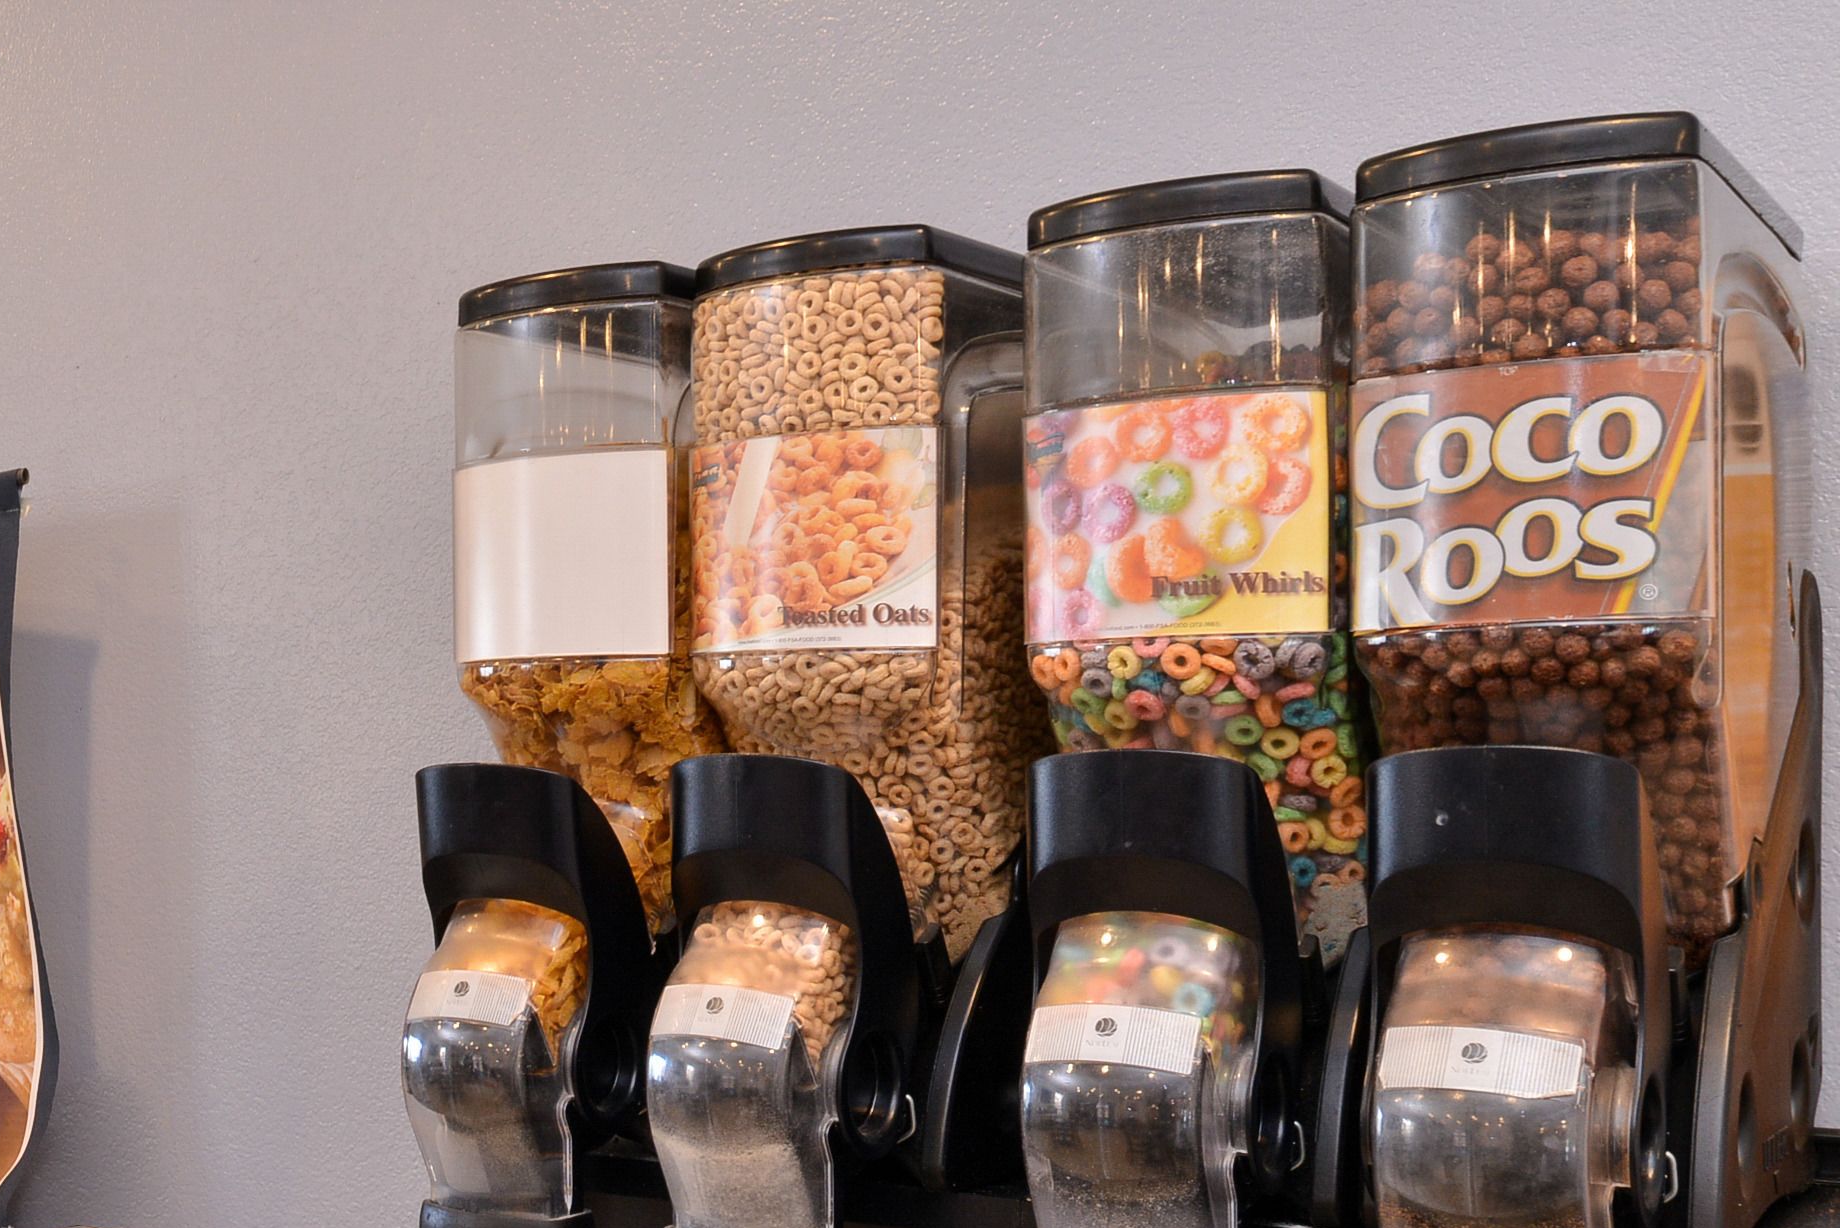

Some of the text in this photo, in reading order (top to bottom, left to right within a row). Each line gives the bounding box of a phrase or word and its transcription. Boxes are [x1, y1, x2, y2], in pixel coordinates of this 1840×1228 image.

[1150, 570, 1325, 600] Fruit Whirls
[777, 602, 931, 629] Toasted Oats
